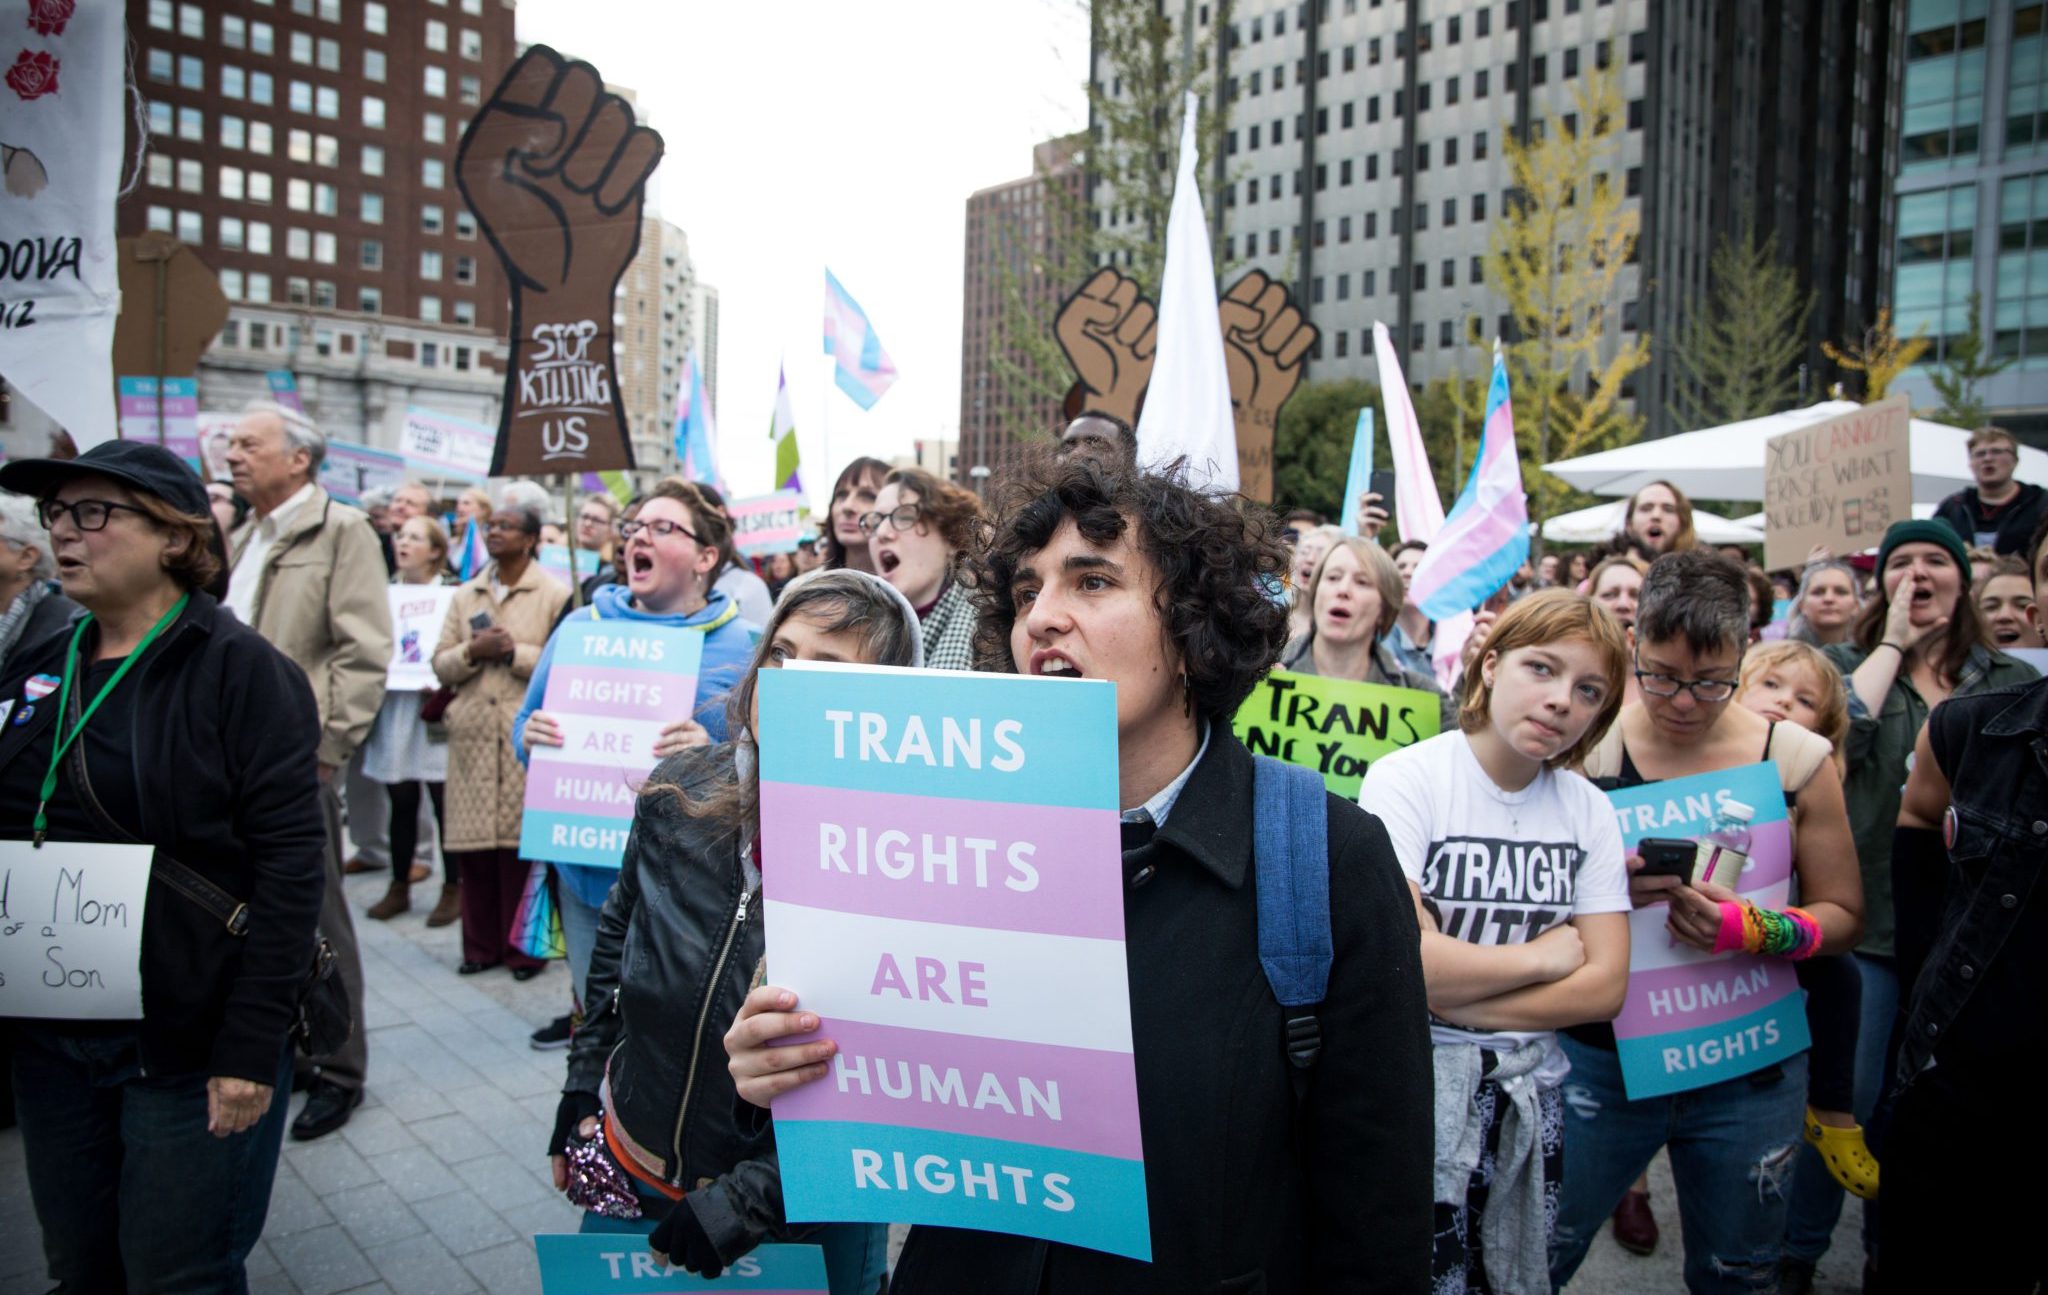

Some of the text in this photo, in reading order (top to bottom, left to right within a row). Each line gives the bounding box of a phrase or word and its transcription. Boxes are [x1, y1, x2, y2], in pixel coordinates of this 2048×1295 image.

[0, 300, 36, 328] 12
[530, 319, 598, 361] STOP
[135, 382, 182, 394] TRNS
[519, 364, 612, 406] KILLING
[542, 416, 589, 452] US
[1767, 407, 1904, 474] YOU CANNOT
[1832, 449, 1897, 486] WHAT
[582, 635, 665, 661] TRANS
[568, 678, 663, 707] RIGHTS
[1267, 678, 1419, 747] TRANS
[583, 731, 634, 754] ARE
[825, 710, 1026, 773] TRANS
[554, 777, 634, 804] HUMA
[552, 823, 631, 851] RIGHT
[819, 822, 1040, 893] RIGHTS
[1421, 840, 1578, 903] STRAIGH
[53, 867, 127, 928] Mom
[42, 946, 105, 988] Son
[870, 951, 990, 1008] ARE
[1648, 963, 1770, 1017] HUMAN
[1662, 1018, 1780, 1074] RIGHTS
[835, 1053, 1063, 1121] HUMAN
[850, 1148, 1076, 1213] RIGHTS
[601, 1252, 762, 1280] TRS
